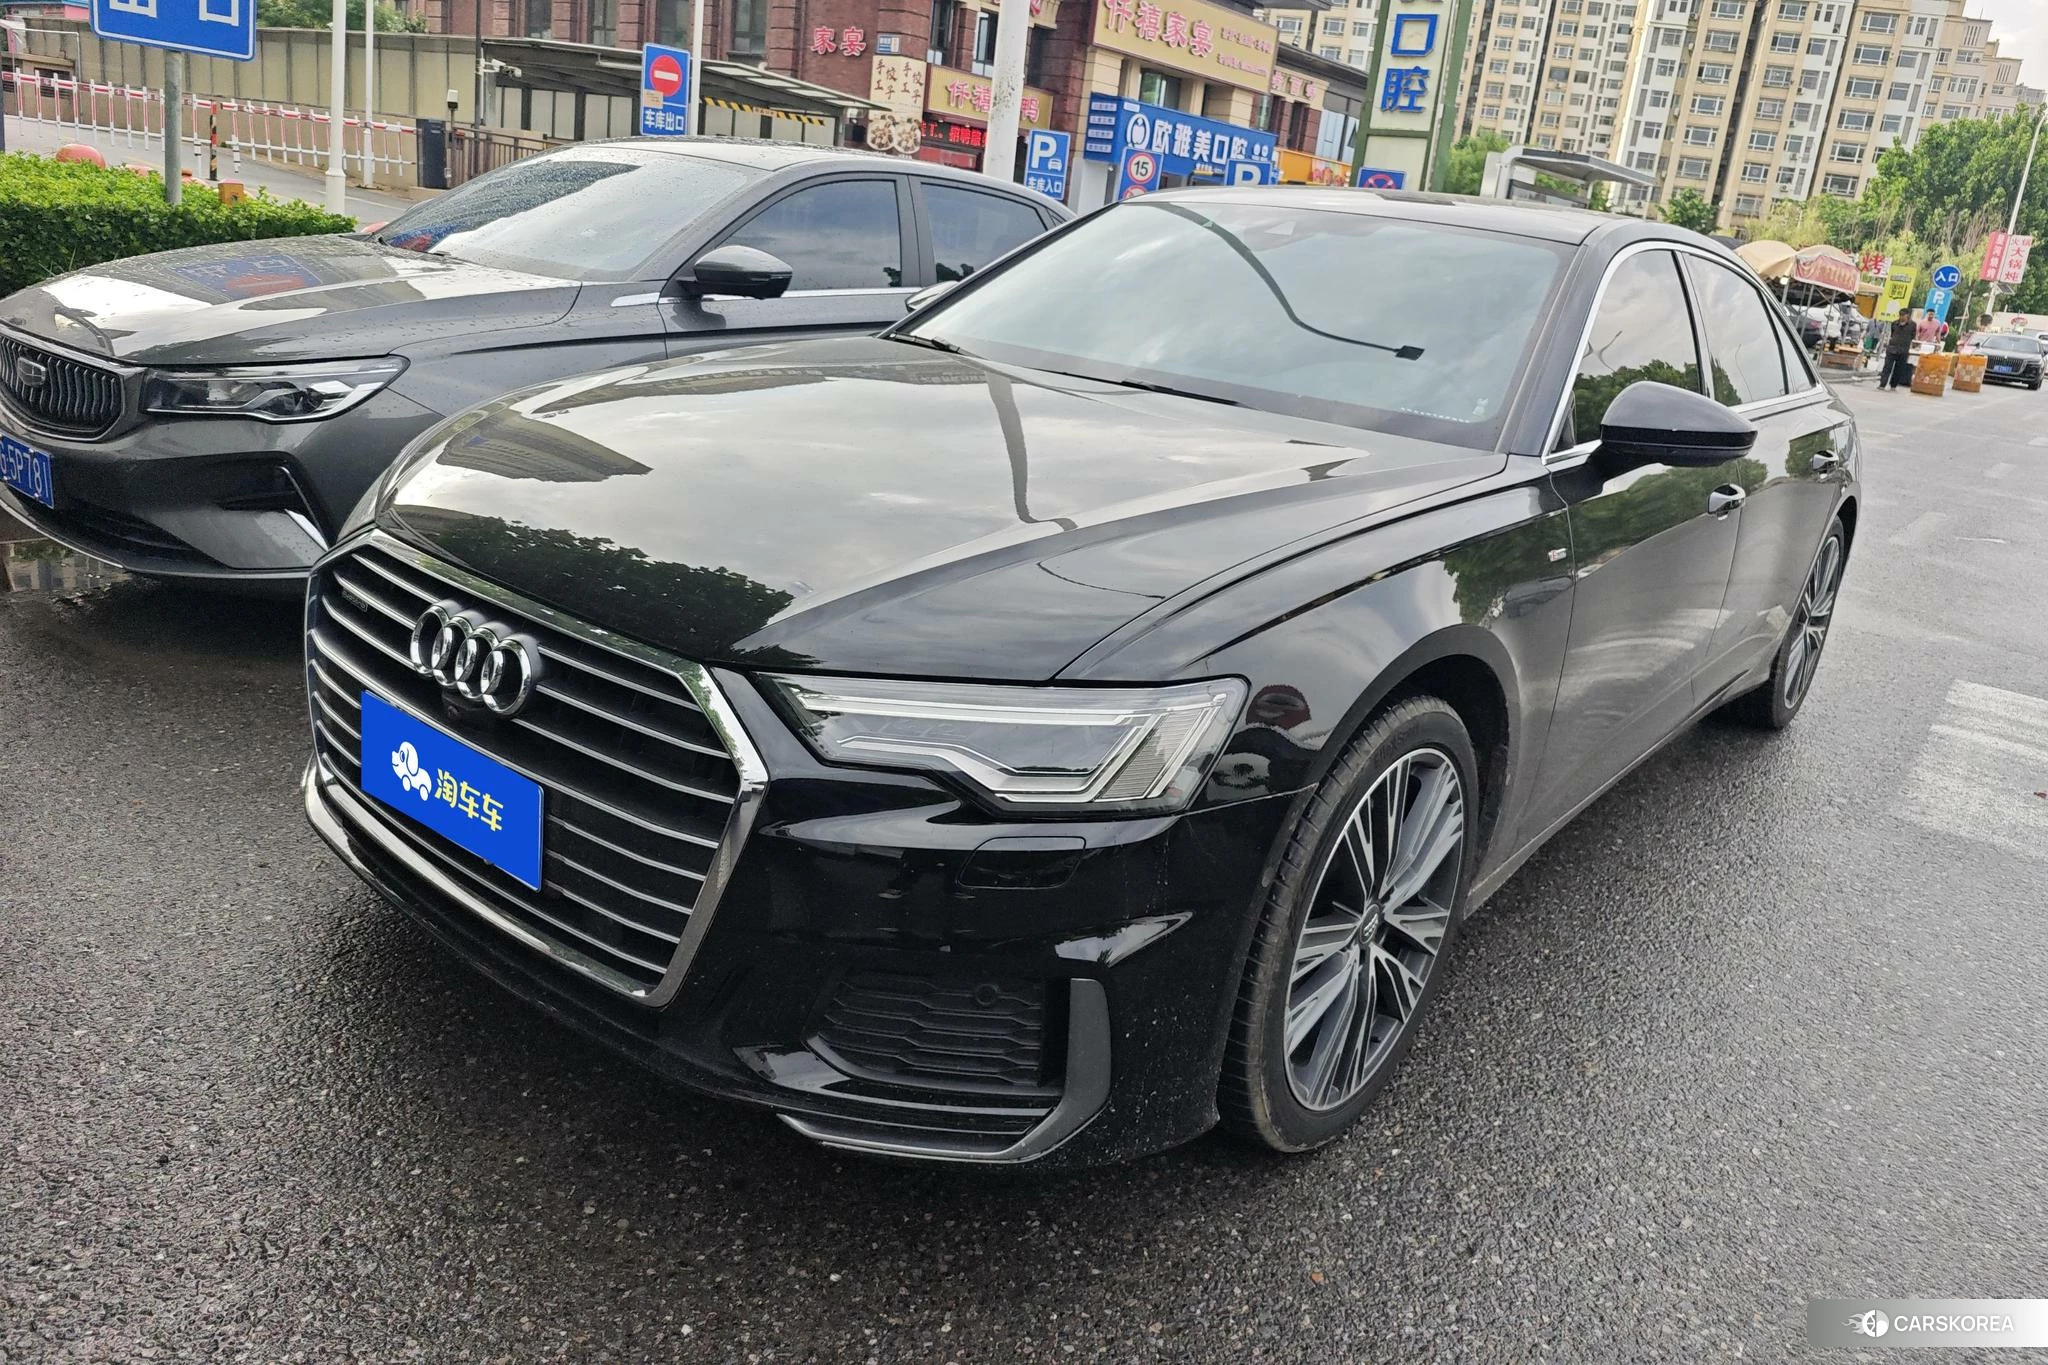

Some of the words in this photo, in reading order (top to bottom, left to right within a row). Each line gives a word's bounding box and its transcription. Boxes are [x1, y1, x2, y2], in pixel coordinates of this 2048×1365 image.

[810, 26, 866, 56] 家宴
[645, 109, 684, 131] 车库出口
[1031, 134, 1057, 169] P
[1152, 118, 1248, 165] 欧雅美口腔
[1134, 159, 1149, 176] 15
[1935, 270, 1959, 282] 入口
